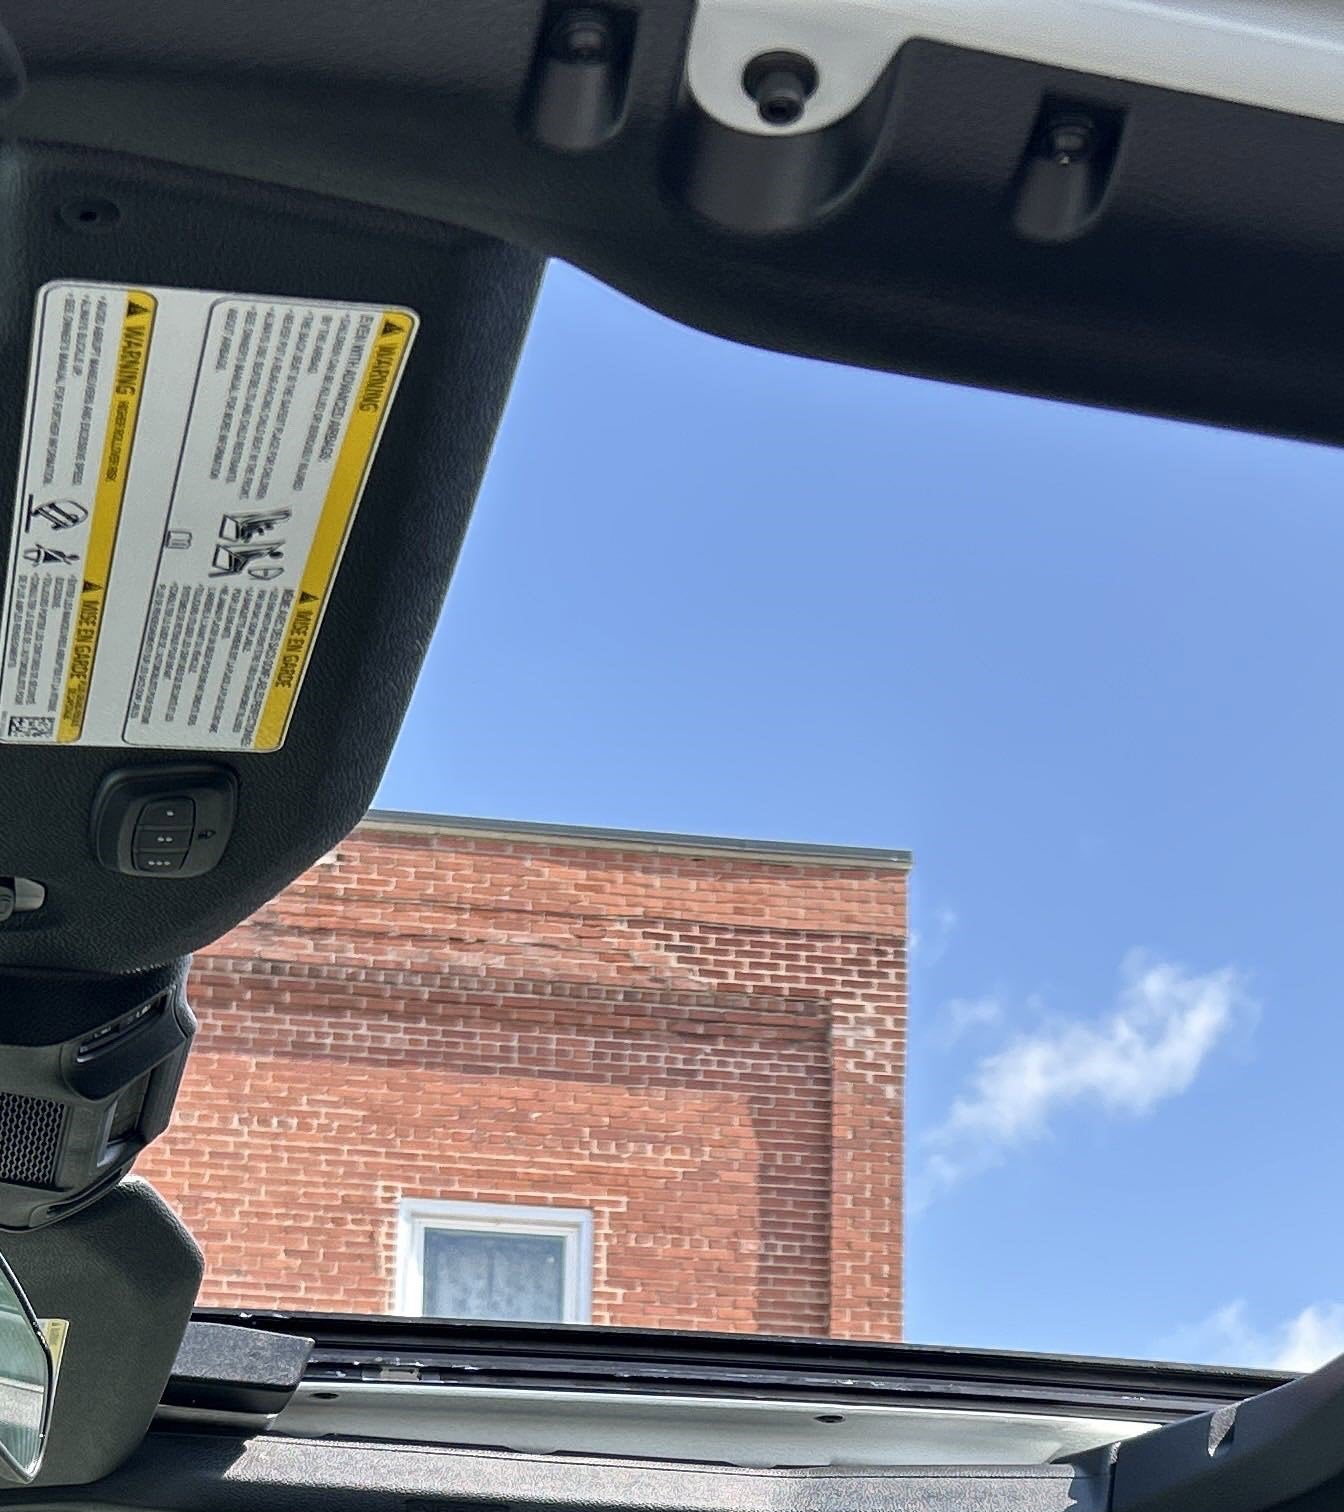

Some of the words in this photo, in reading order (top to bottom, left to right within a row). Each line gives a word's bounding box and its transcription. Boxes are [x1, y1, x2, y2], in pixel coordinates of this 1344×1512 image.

[353, 314, 374, 341] EVEN
[114, 324, 146, 396] WARNING
[345, 343, 365, 369] WITH
[357, 344, 398, 413] WARNING
[330, 369, 357, 418] ADVANCED
[78, 599, 100, 626] MISE
[290, 610, 314, 636] MISE
[75, 628, 95, 642] EN
[285, 638, 305, 652] EN
[69, 644, 92, 679] GARDE
[274, 654, 300, 688] GARDE
